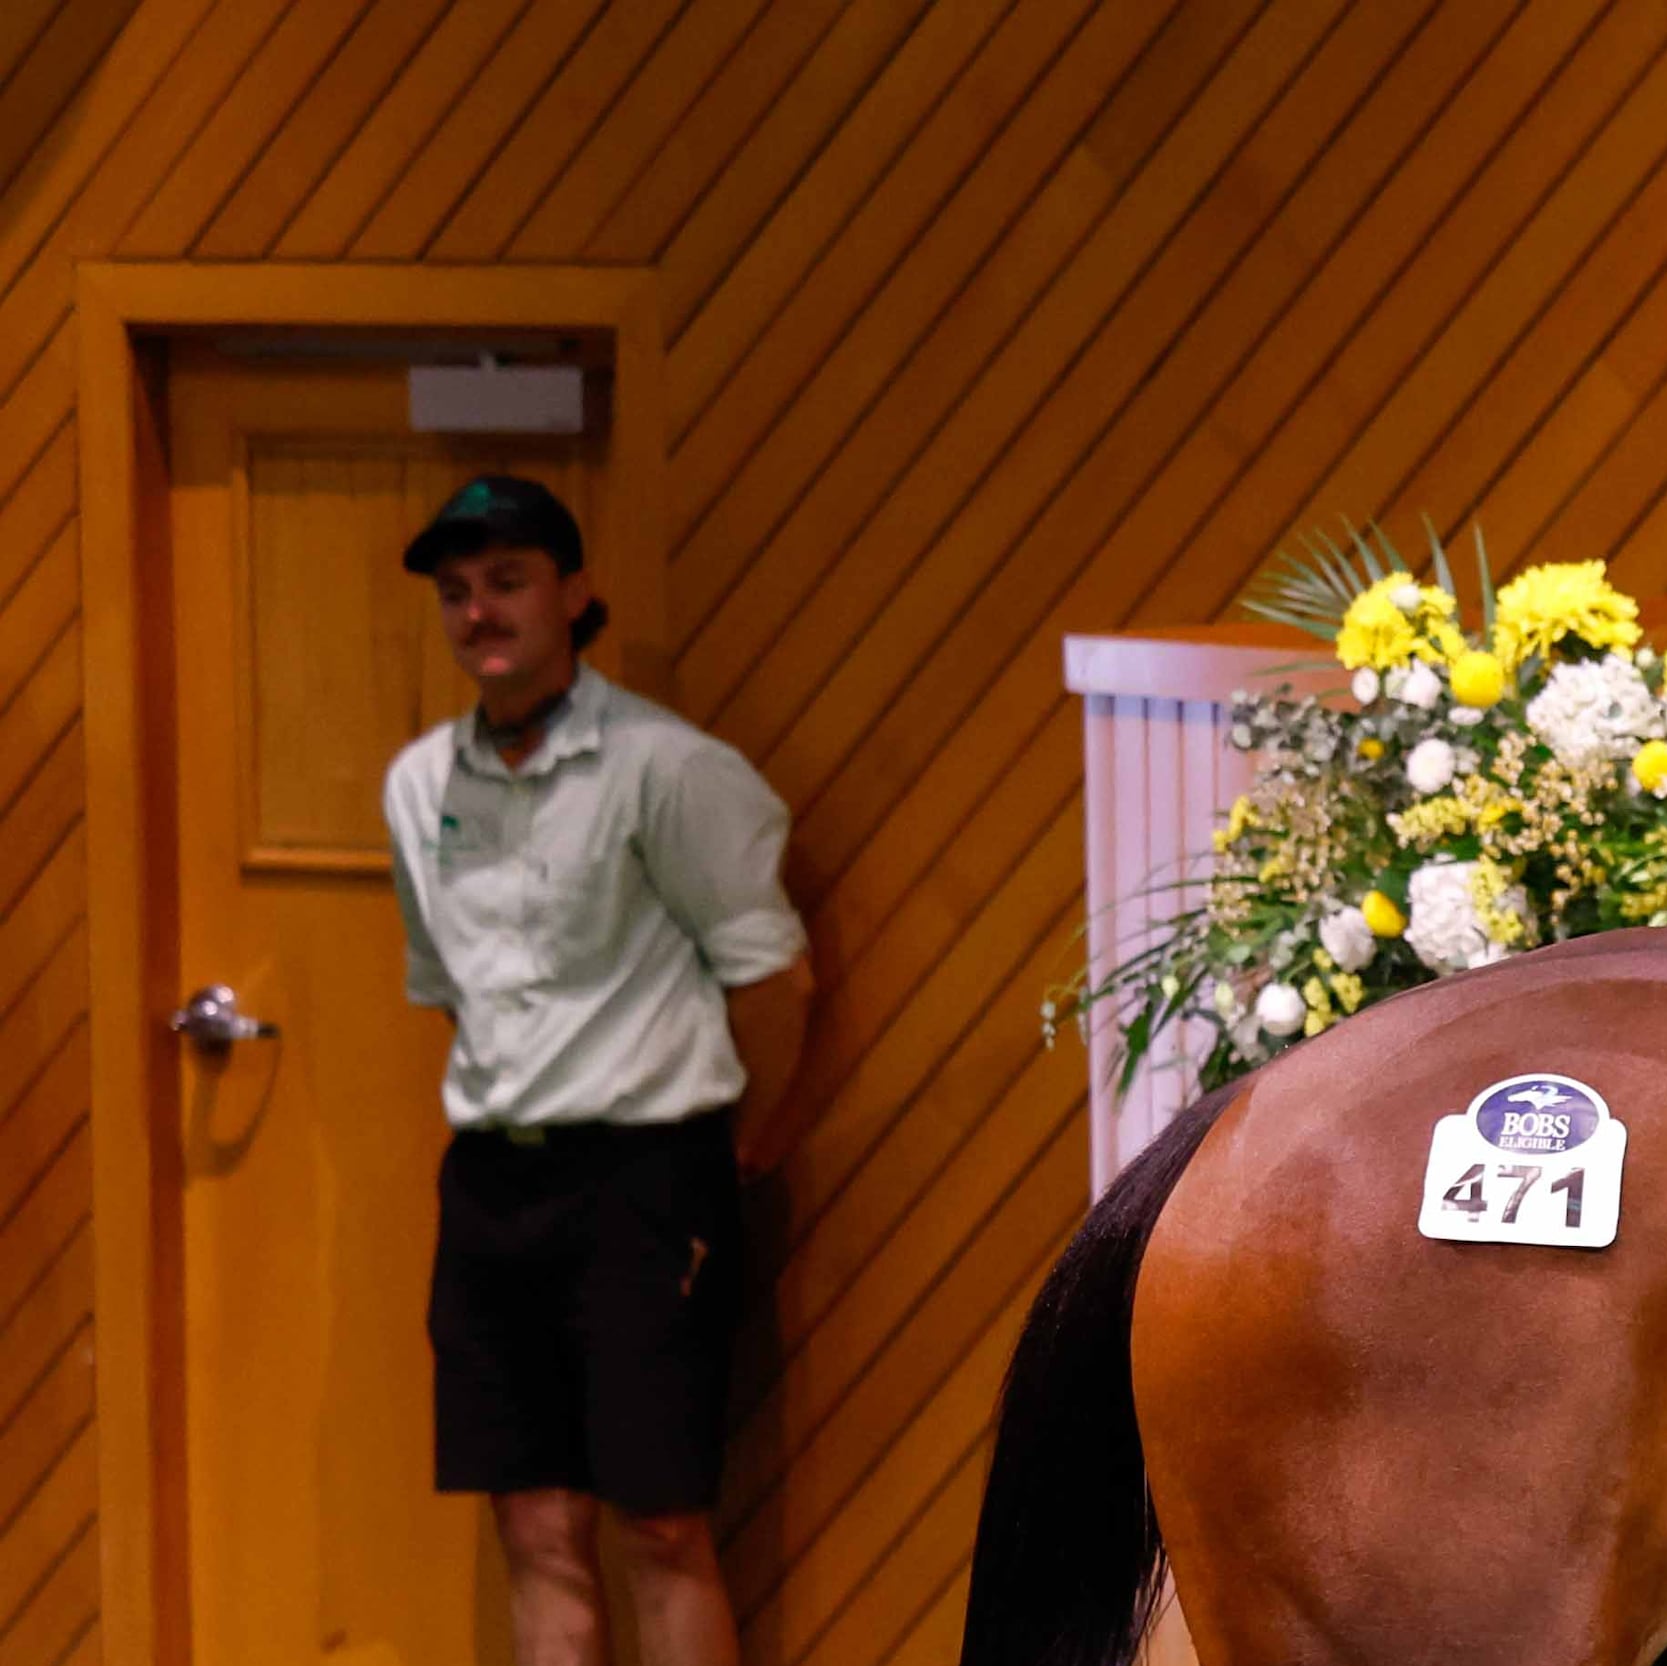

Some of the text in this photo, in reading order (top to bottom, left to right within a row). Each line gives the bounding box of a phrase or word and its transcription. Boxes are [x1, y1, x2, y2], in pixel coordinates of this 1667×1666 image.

[1501, 1111, 1571, 1139] BOBS
[1498, 1136, 1566, 1151] ELIGIBLE
[1441, 1163, 1586, 1229] 471
